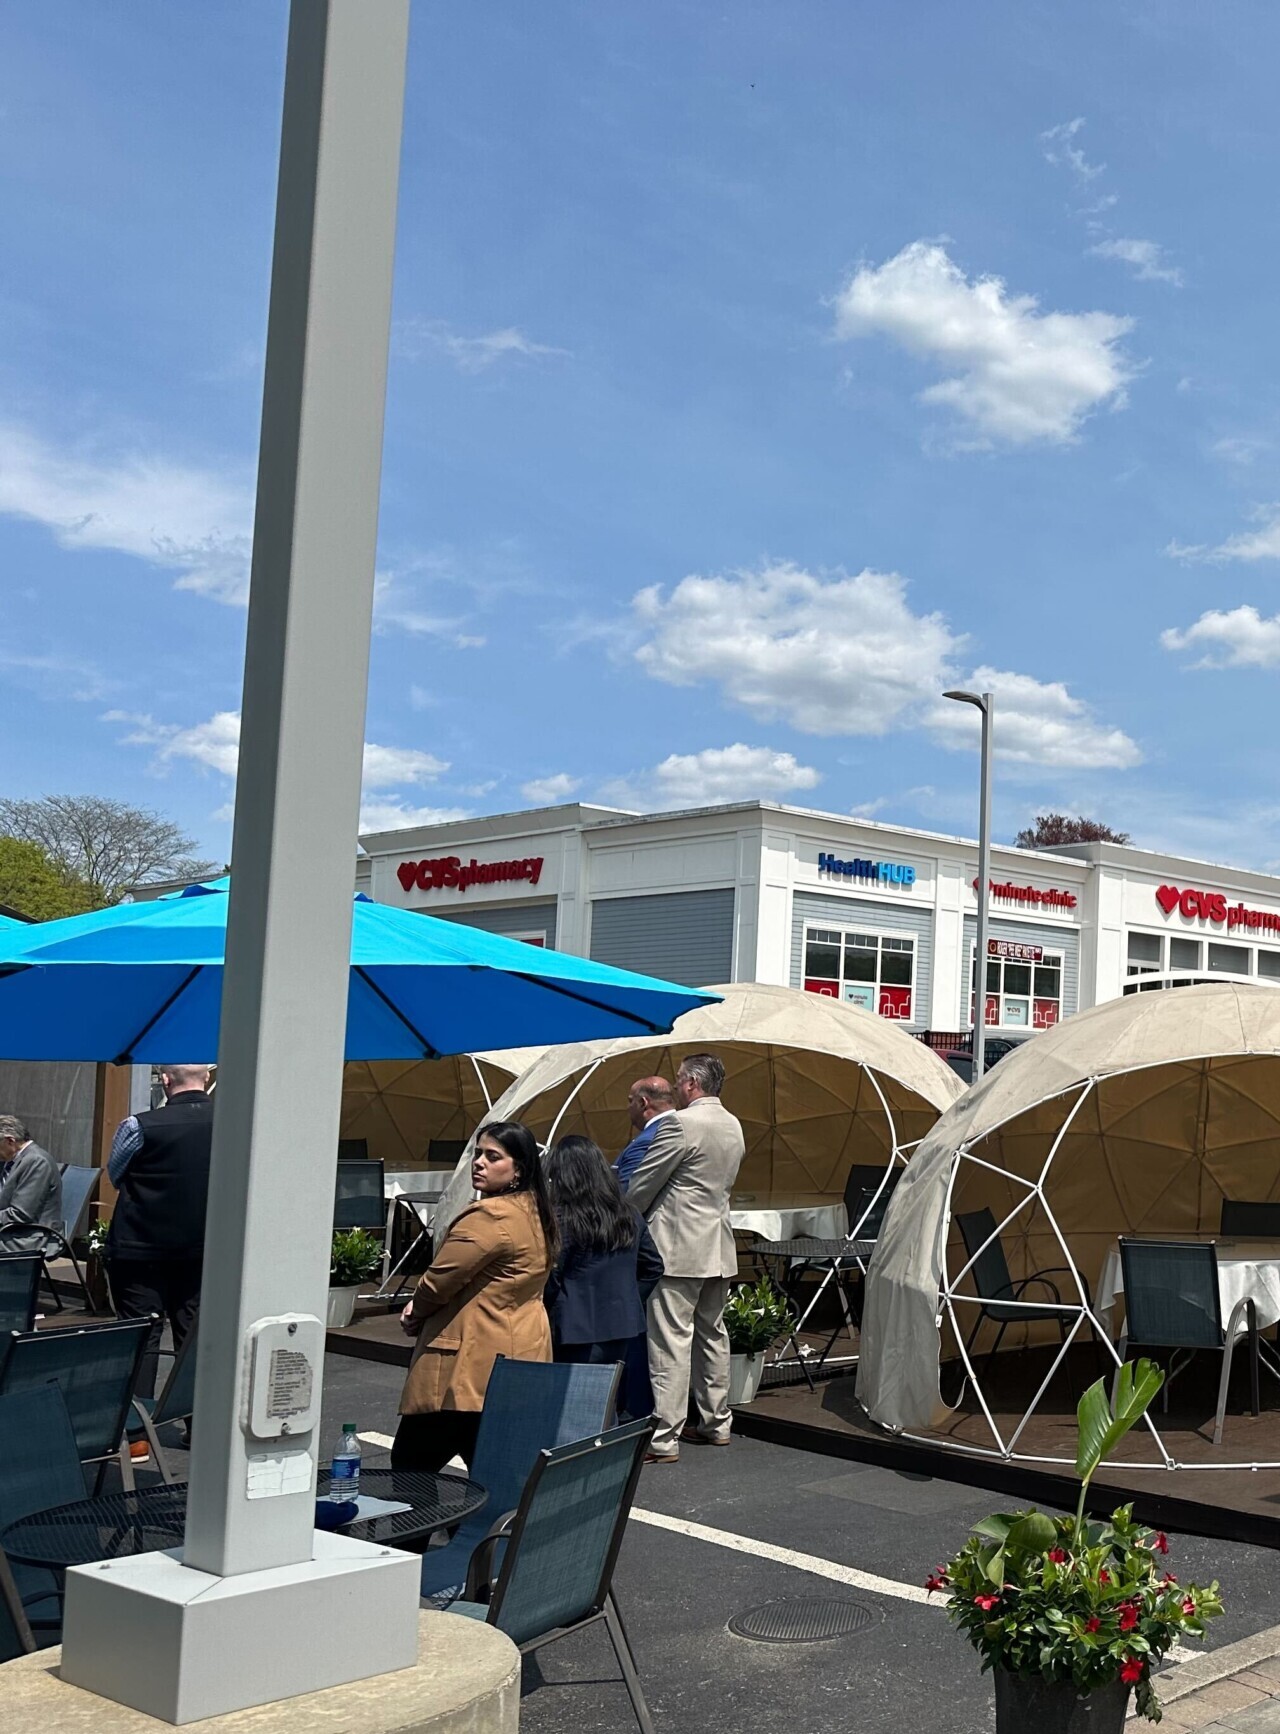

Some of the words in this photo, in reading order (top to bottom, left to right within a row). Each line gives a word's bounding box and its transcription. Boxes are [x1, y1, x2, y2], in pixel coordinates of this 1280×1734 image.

[416, 856, 461, 891] CVS
[459, 857, 544, 892] pharmacy
[1179, 889, 1228, 922] CVS
